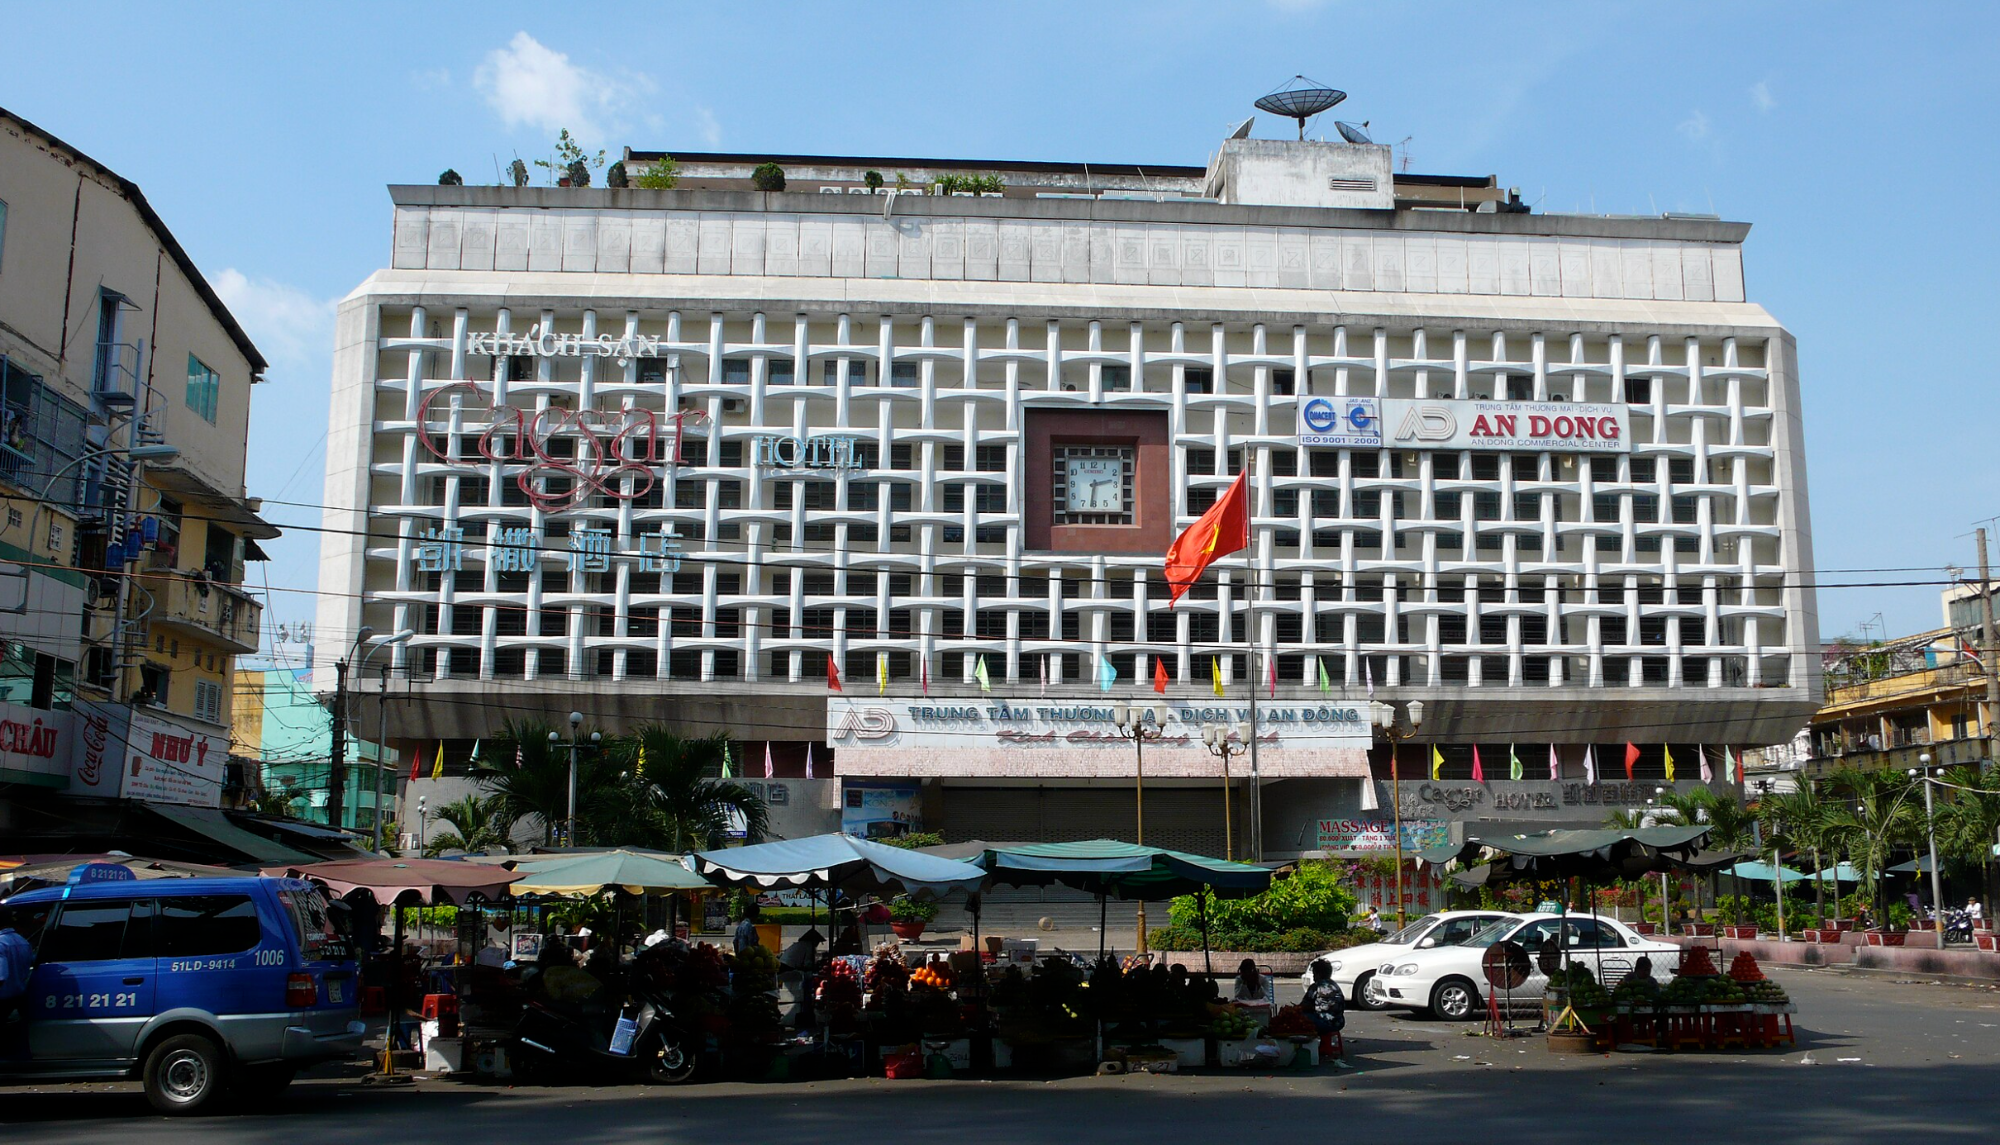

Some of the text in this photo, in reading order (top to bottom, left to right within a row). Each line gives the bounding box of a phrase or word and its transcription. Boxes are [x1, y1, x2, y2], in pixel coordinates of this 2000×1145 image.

[467, 323, 661, 367] KHÁCH SẠN
[1475, 403, 1501, 411] TRUNG
[1504, 402, 1521, 411] TÂM
[1525, 403, 1557, 412] THƯƠNG
[1469, 414, 1621, 440] AN DONG
[416, 376, 708, 512] Caesar
[1322, 436, 1346, 444] 9001
[1518, 440, 1579, 448] COMMERCIAL
[1582, 440, 1620, 448] CENTER
[1090, 461, 1098, 469] 12
[1112, 468, 1118, 477] 2
[1070, 480, 1076, 488] 9
[1112, 480, 1118, 489] 3
[1080, 500, 1086, 508] 7
[1103, 500, 1108, 508] 5
[908, 706, 979, 721] TRUNG
[986, 703, 1029, 721] TÂM
[1181, 708, 1228, 726] DỊCH
[1267, 708, 1295, 722] AN
[0, 717, 58, 759] CHÂU
[150, 732, 208, 766] NHƯ Ý
[1319, 820, 1390, 833] MASSAGE
[91, 868, 128, 880] 8 21 21 21
[254, 949, 284, 966] 1006
[171, 959, 236, 972] 51LD-9414
[46, 992, 136, 1008] 8 21 21 21
